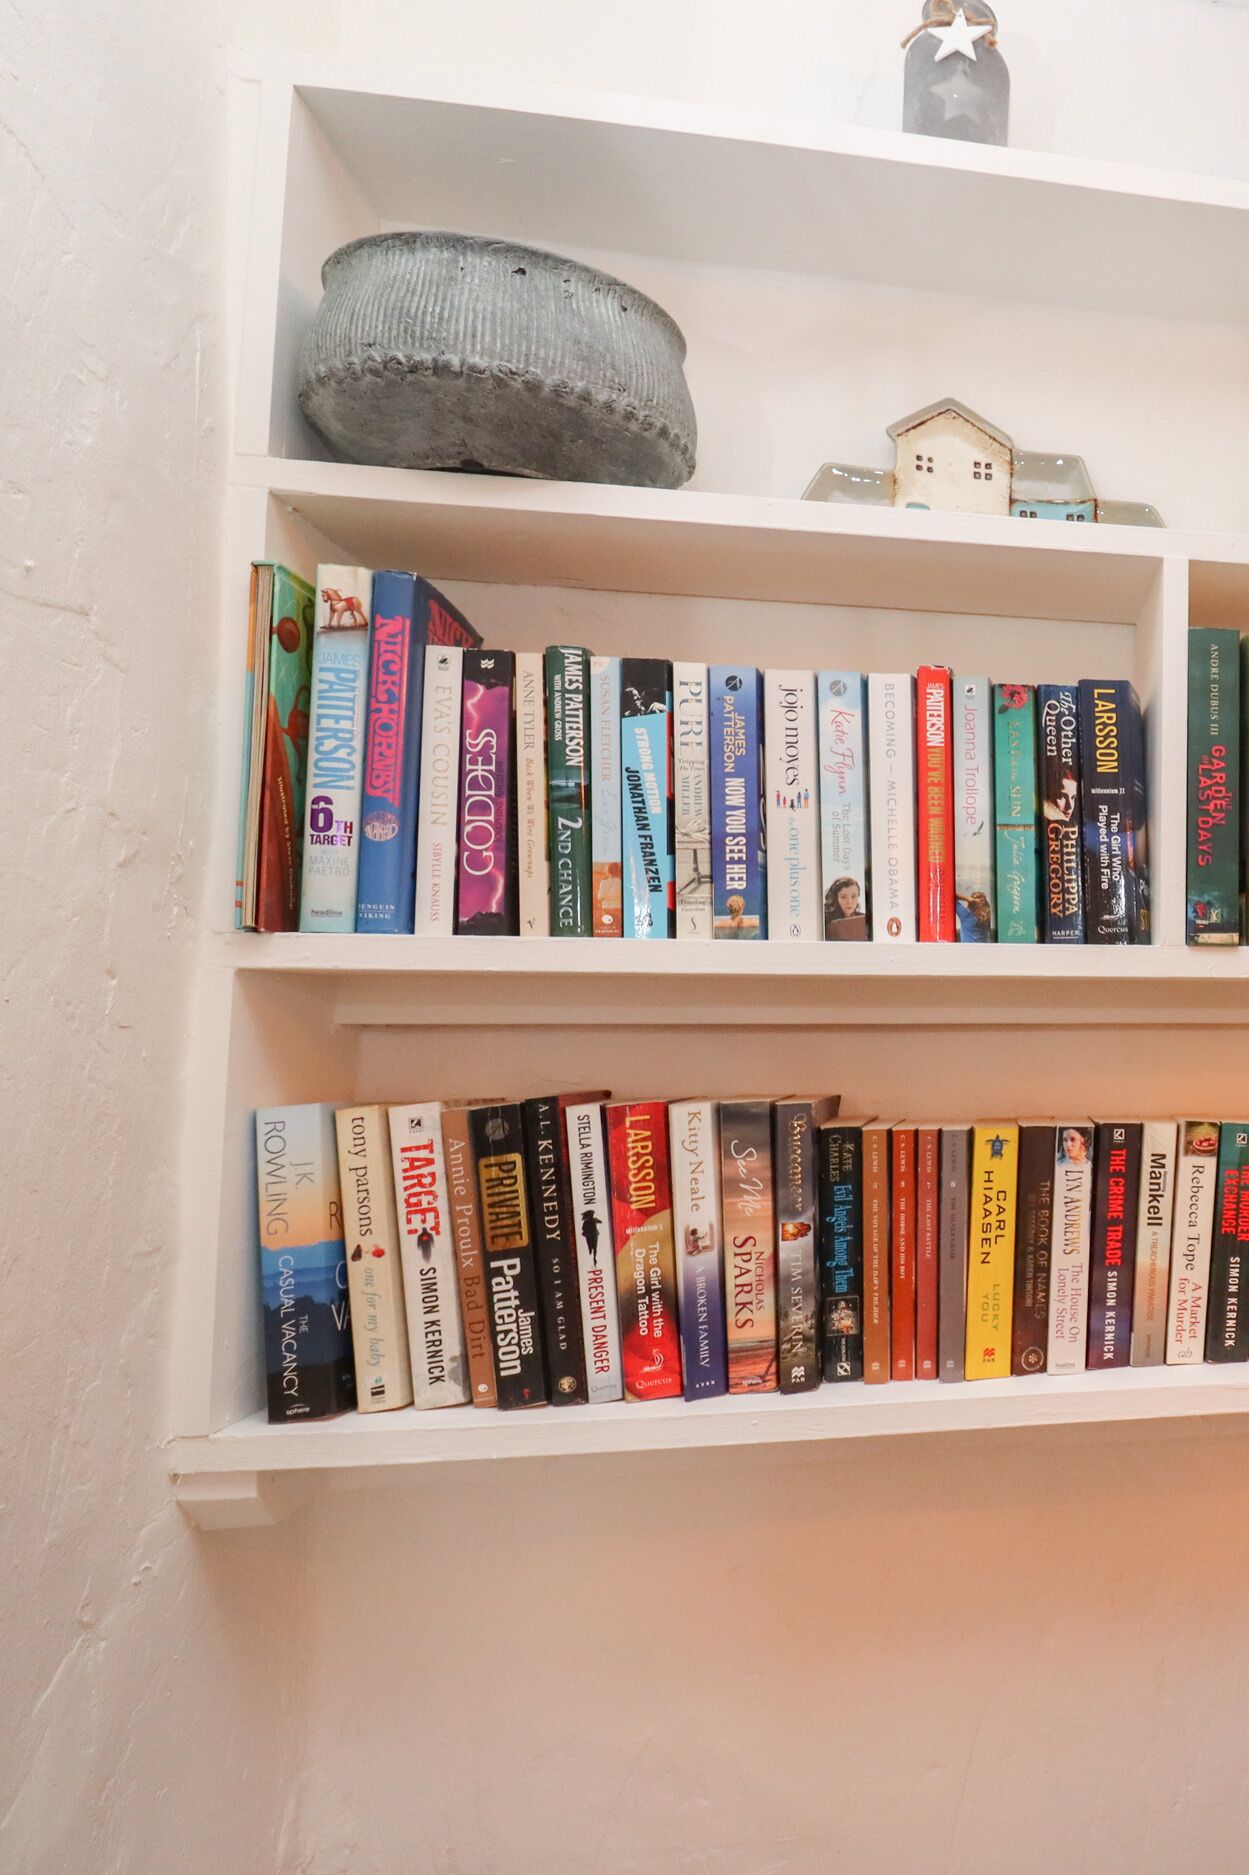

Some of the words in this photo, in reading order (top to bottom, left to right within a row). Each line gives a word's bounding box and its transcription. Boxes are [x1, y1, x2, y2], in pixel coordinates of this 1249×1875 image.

[371, 614, 410, 702] NICK
[559, 649, 583, 689] JAMES
[1210, 644, 1219, 680] ANDRE
[523, 671, 534, 708] ANNE
[553, 675, 561, 690] WITH
[554, 691, 562, 717] ANDREW
[779, 684, 803, 722] jojo
[1060, 691, 1076, 715] The
[1210, 684, 1219, 720] DUBUS
[313, 667, 357, 790] PATTERSON
[434, 686, 452, 734] EVA'S
[523, 711, 535, 750] TYLER
[554, 718, 562, 741] GROSS
[565, 691, 584, 766] PATTERSON
[831, 708, 855, 744] Katie
[884, 683, 896, 758] BECOMING
[926, 689, 944, 746] PATTERSON
[1042, 700, 1060, 756] Queen
[1093, 688, 1119, 773] LARSSON
[365, 699, 405, 807] HORNBY
[634, 727, 654, 771] STRONG
[724, 695, 735, 772] PATTERSON
[735, 713, 746, 756] JAMES
[964, 705, 978, 760] Joanna
[1060, 718, 1077, 766] Other
[780, 727, 800, 786] moyes
[824, 747, 855, 796] Flynn
[431, 743, 448, 826] COUSIN
[464, 728, 496, 875] GODDESS
[642, 772, 663, 815] MOTION
[725, 778, 745, 807] NOW
[962, 765, 979, 825] Trollope
[1198, 761, 1213, 811] LAST
[1210, 745, 1227, 825] GARDEN
[557, 816, 583, 854] 2ND
[625, 767, 650, 832] JONATHAN
[638, 835, 663, 893] FRANZEN
[726, 809, 746, 833] YOU
[887, 780, 897, 849] MICHELLE
[1098, 805, 1108, 842] Played
[1111, 813, 1120, 832] The
[310, 834, 352, 846] TARGET
[432, 843, 442, 880] SIBYLLE
[725, 836, 747, 861] SEE
[1100, 843, 1109, 867] with
[1111, 834, 1121, 855] Girl
[1197, 816, 1213, 866] DAYS
[726, 865, 747, 890] HER
[888, 857, 898, 910] OBAMA
[1048, 823, 1063, 917] GREGORY
[1062, 825, 1079, 915] PHILIPPA
[1100, 868, 1110, 890] Fire
[1112, 857, 1120, 881] Who
[430, 880, 441, 922] KNAUSS
[558, 858, 573, 928] CHANCE
[348, 1116, 367, 1158] tony
[577, 1115, 592, 1150] STELLA
[682, 1111, 701, 1157] Kitty
[264, 1120, 289, 1236] ROWLING
[449, 1138, 469, 1196] Annie
[580, 1153, 597, 1205] RIMINGTON
[625, 1115, 656, 1210] LARSSON
[731, 1140, 757, 1179] See
[1065, 1169, 1084, 1193] LYN
[1110, 1149, 1127, 1173] THE
[349, 1166, 373, 1237] parsons
[400, 1138, 441, 1236] TARGET
[484, 1161, 524, 1245] PRIVATE
[538, 1140, 561, 1241] KENNEDY
[689, 1161, 706, 1212] Neale
[738, 1177, 763, 1217] Me
[1107, 1178, 1126, 1219] CRIME
[1147, 1153, 1167, 1226] Mankell
[1188, 1165, 1205, 1228] Rebecca
[1222, 1169, 1239, 1234] EXCHANGE
[456, 1203, 478, 1268] Proulx
[981, 1170, 994, 1264] HIAASEN
[994, 1190, 1007, 1245] CARL
[1063, 1194, 1081, 1255] ANDREWS
[649, 1242, 659, 1264] The
[791, 1250, 802, 1282] TIM
[1105, 1224, 1123, 1266] TRADE
[1183, 1234, 1200, 1271] Tope
[278, 1255, 296, 1318] CASUAL
[419, 1267, 440, 1315] SIMON
[463, 1275, 483, 1311] Bad
[634, 1248, 645, 1294] Dragon
[650, 1267, 661, 1289] Girl
[733, 1236, 756, 1329] SPARKS
[754, 1251, 765, 1311] NICHOLAS
[1057, 1268, 1069, 1305] Lonely
[1071, 1263, 1083, 1283] The
[1106, 1271, 1117, 1306] SIMON
[1178, 1278, 1190, 1295] for
[1192, 1282, 1202, 1292] A
[1228, 1256, 1240, 1292] SIMON
[587, 1269, 607, 1321] PRESENT
[638, 1296, 648, 1336] Tattoo
[651, 1291, 663, 1317] with
[696, 1276, 709, 1323] BROKEN
[982, 1293, 990, 1322] YOU
[992, 1284, 1000, 1330] LUCKY
[1069, 1287, 1082, 1323] House
[299, 1314, 308, 1332] THE
[490, 1258, 522, 1377] Patterson
[517, 1309, 535, 1355] James
[557, 1317, 567, 1350] GLAD
[653, 1319, 664, 1338] the
[791, 1288, 803, 1353] SEVERIN
[1055, 1307, 1068, 1339] Street
[1069, 1325, 1080, 1343] On
[1103, 1311, 1115, 1360] KERNICK
[1175, 1300, 1187, 1344] Murder
[1189, 1297, 1201, 1339] Market
[1224, 1297, 1239, 1347] KERNICK
[280, 1320, 299, 1396] VACANCY
[424, 1319, 445, 1385] KERNICK
[468, 1320, 486, 1360] Dirt
[591, 1324, 611, 1374] DANGER
[698, 1325, 710, 1368] FAMILY
[286, 1406, 310, 1416] sphere
